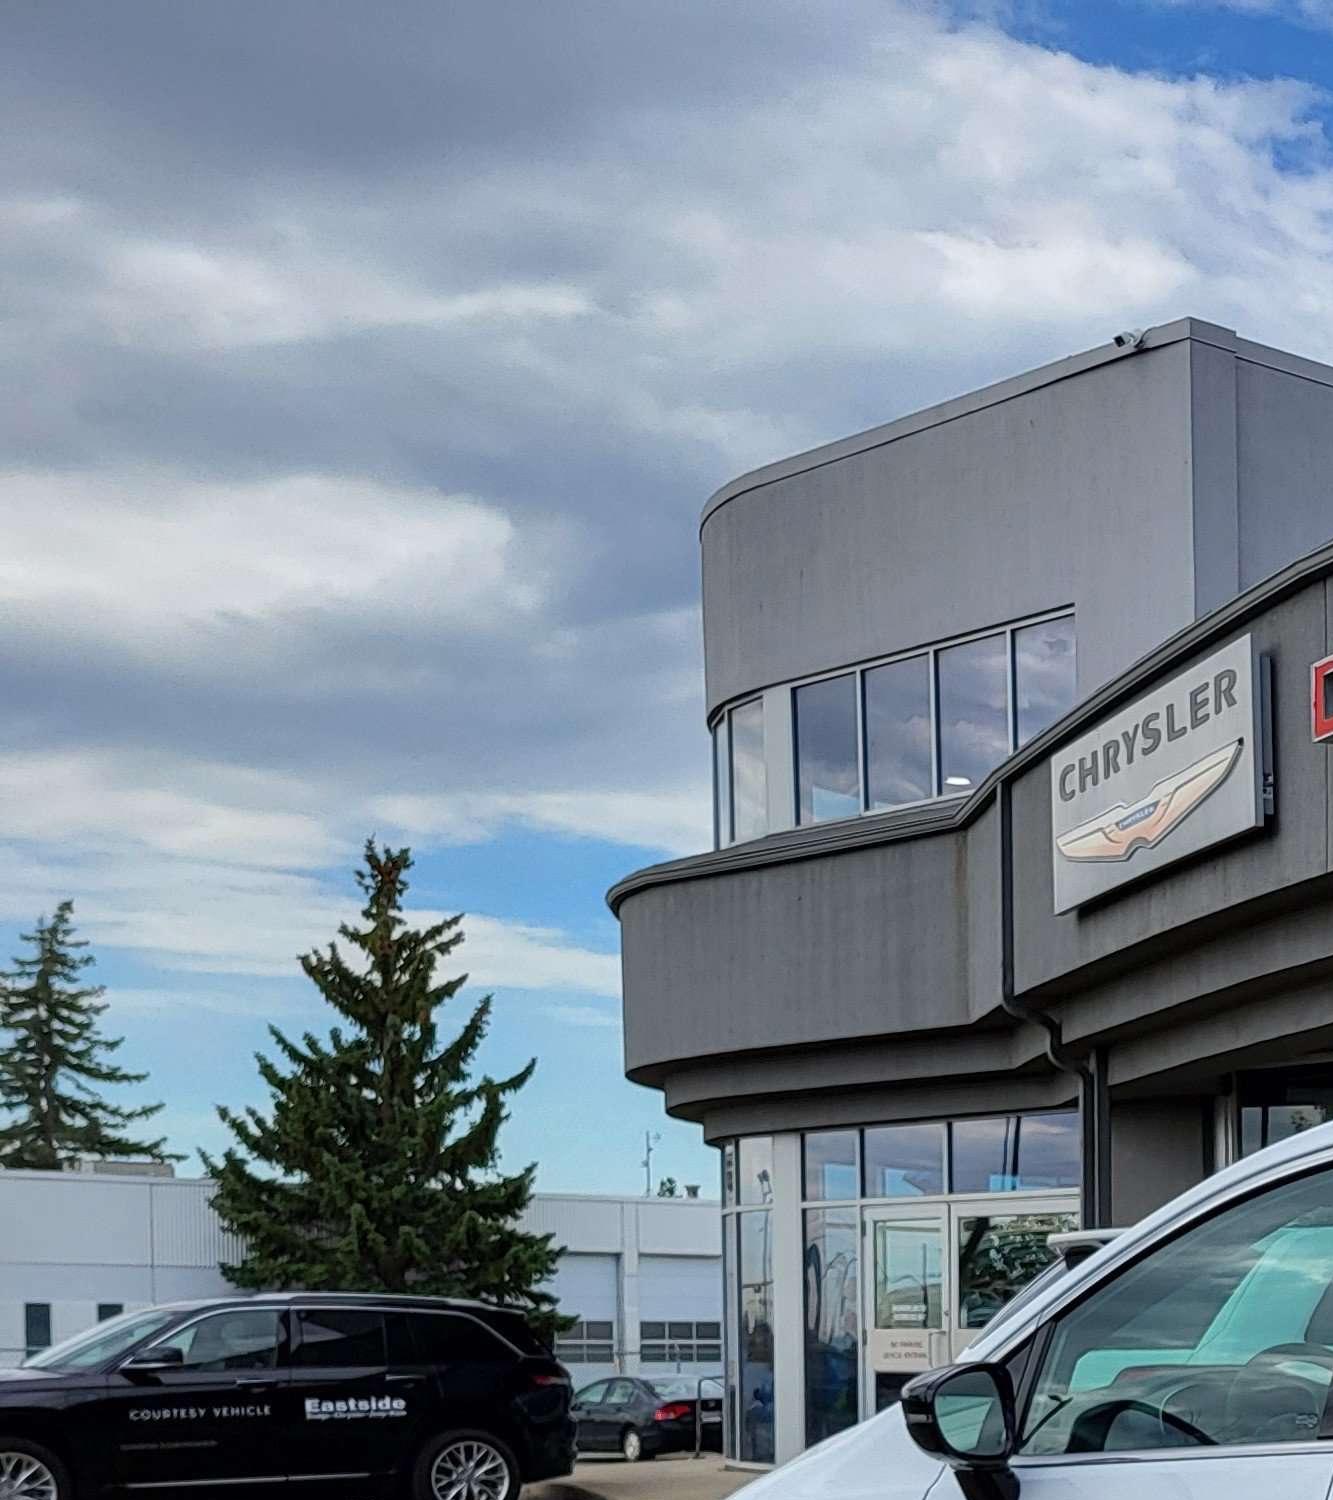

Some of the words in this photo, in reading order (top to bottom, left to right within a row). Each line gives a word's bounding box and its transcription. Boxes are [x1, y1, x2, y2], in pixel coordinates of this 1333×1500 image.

[1059, 669, 1237, 802] CHRYSLER
[305, 1395, 406, 1412] Eastside
[128, 1408, 206, 1420] COURTESY
[213, 1405, 271, 1417] VEHICLE
